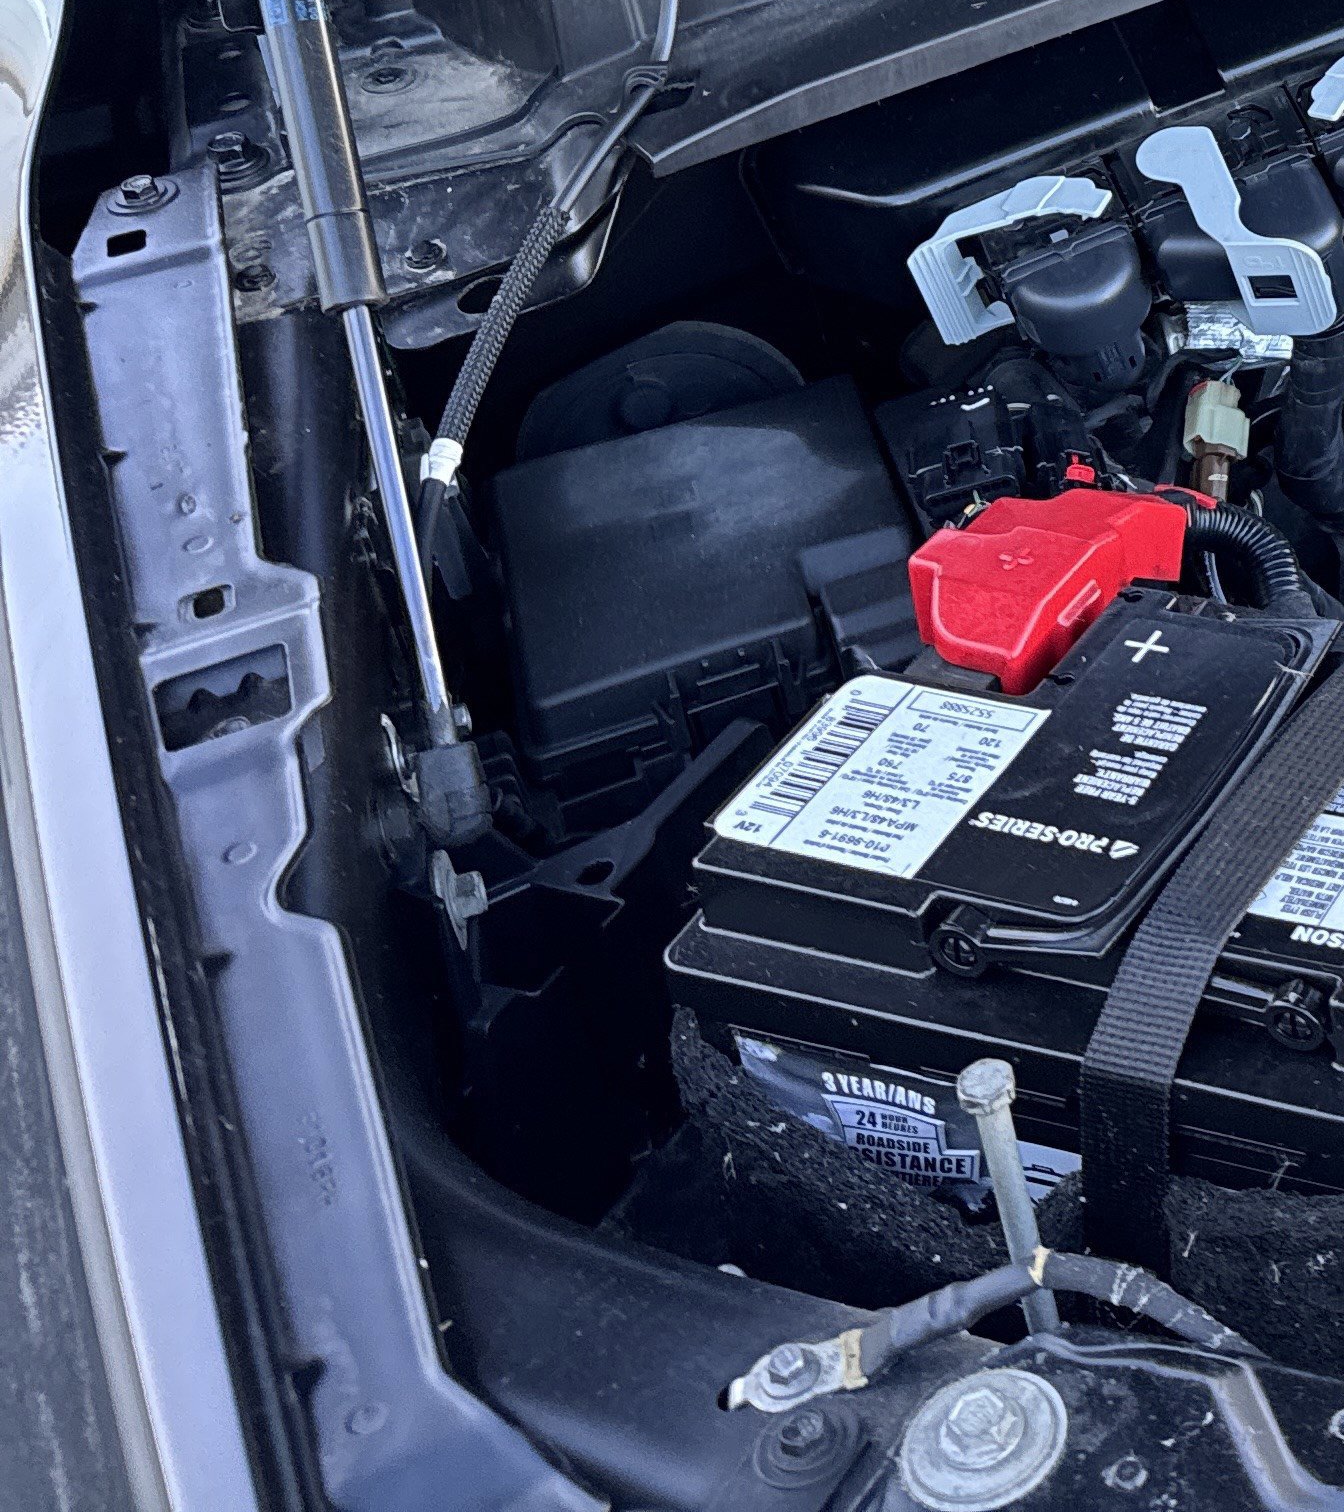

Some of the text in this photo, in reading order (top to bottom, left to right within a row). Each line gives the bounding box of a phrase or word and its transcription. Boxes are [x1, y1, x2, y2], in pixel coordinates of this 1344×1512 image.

[912, 723, 930, 733] 70
[978, 737, 1002, 748] 120
[733, 820, 763, 835] 12V
[821, 1071, 936, 1115] 3 YEAR/ANS
[855, 1110, 909, 1128] 24 HOUR
[881, 1121, 919, 1136] HEURES
[856, 1132, 931, 1155] ROADSIDE
